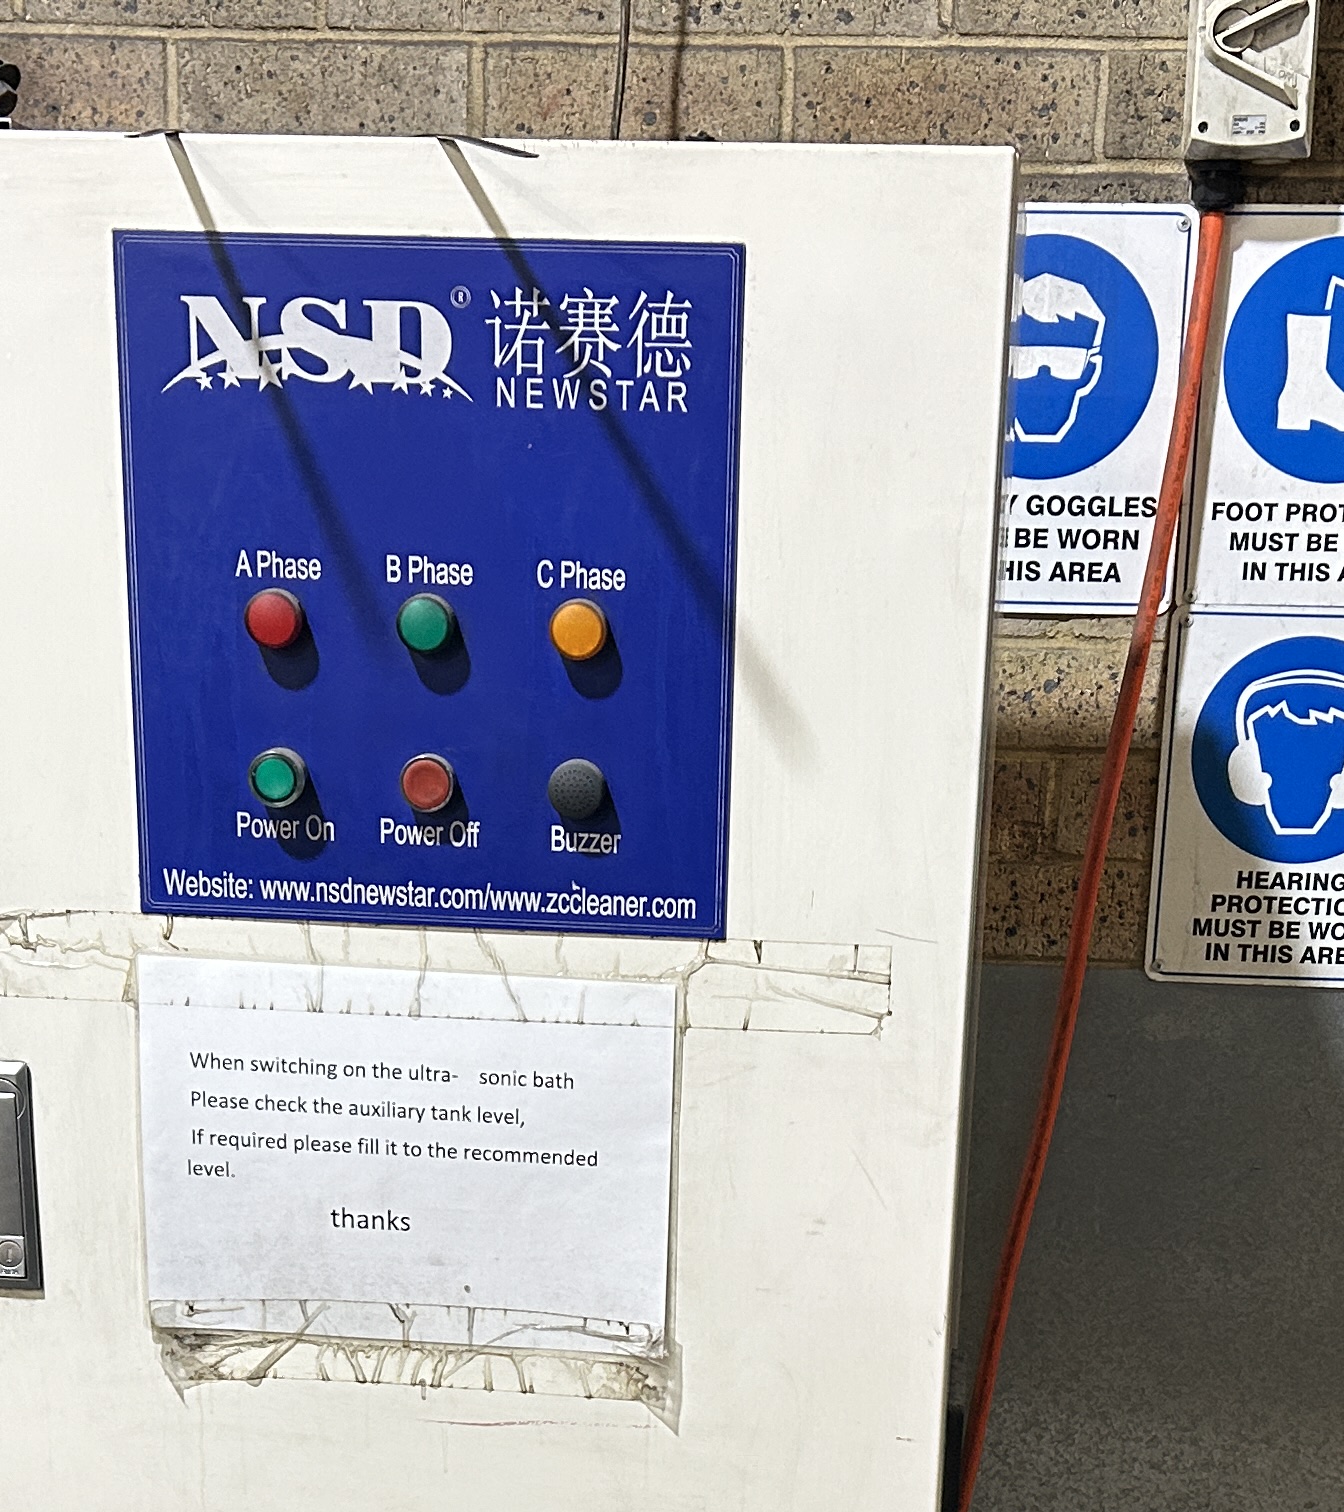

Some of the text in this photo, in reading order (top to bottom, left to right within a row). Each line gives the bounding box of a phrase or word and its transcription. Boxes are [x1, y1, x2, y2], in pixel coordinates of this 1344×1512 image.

[180, 295, 454, 386] NSD
[485, 287, 693, 379] 诺赛德
[496, 378, 688, 412] NEWSTAR
[1026, 494, 1157, 518] GOGGLES
[1212, 502, 1280, 523] FOOT
[1014, 529, 1048, 549] BE
[1055, 529, 1139, 551] WORN
[1229, 533, 1301, 551] MUST
[1306, 534, 1337, 552] BE
[235, 551, 322, 580] A Phase
[386, 556, 474, 586] B Phase
[537, 561, 626, 591] C Phase
[1048, 562, 1121, 583] AREA
[1242, 562, 1267, 580] IN
[1275, 562, 1331, 582] THIS
[236, 814, 335, 843] Power On
[380, 819, 480, 848] Power Off
[551, 827, 622, 855] Buzzer
[163, 869, 696, 920] Website: www.nsdnewstar.com/www.zccleaner.com
[1192, 918, 1261, 936] MUST
[1268, 921, 1300, 939] BE
[1205, 942, 1231, 961] IN
[1237, 944, 1293, 963] THIS
[189, 1053, 574, 1090] When switching on the ultra- sonic bath
[191, 1091, 526, 1128] Please check the auxiliary tank level,
[191, 1129, 598, 1168] If required please fill it to the recommended
[187, 1160, 236, 1179] level.
[330, 1207, 411, 1233] thanks
